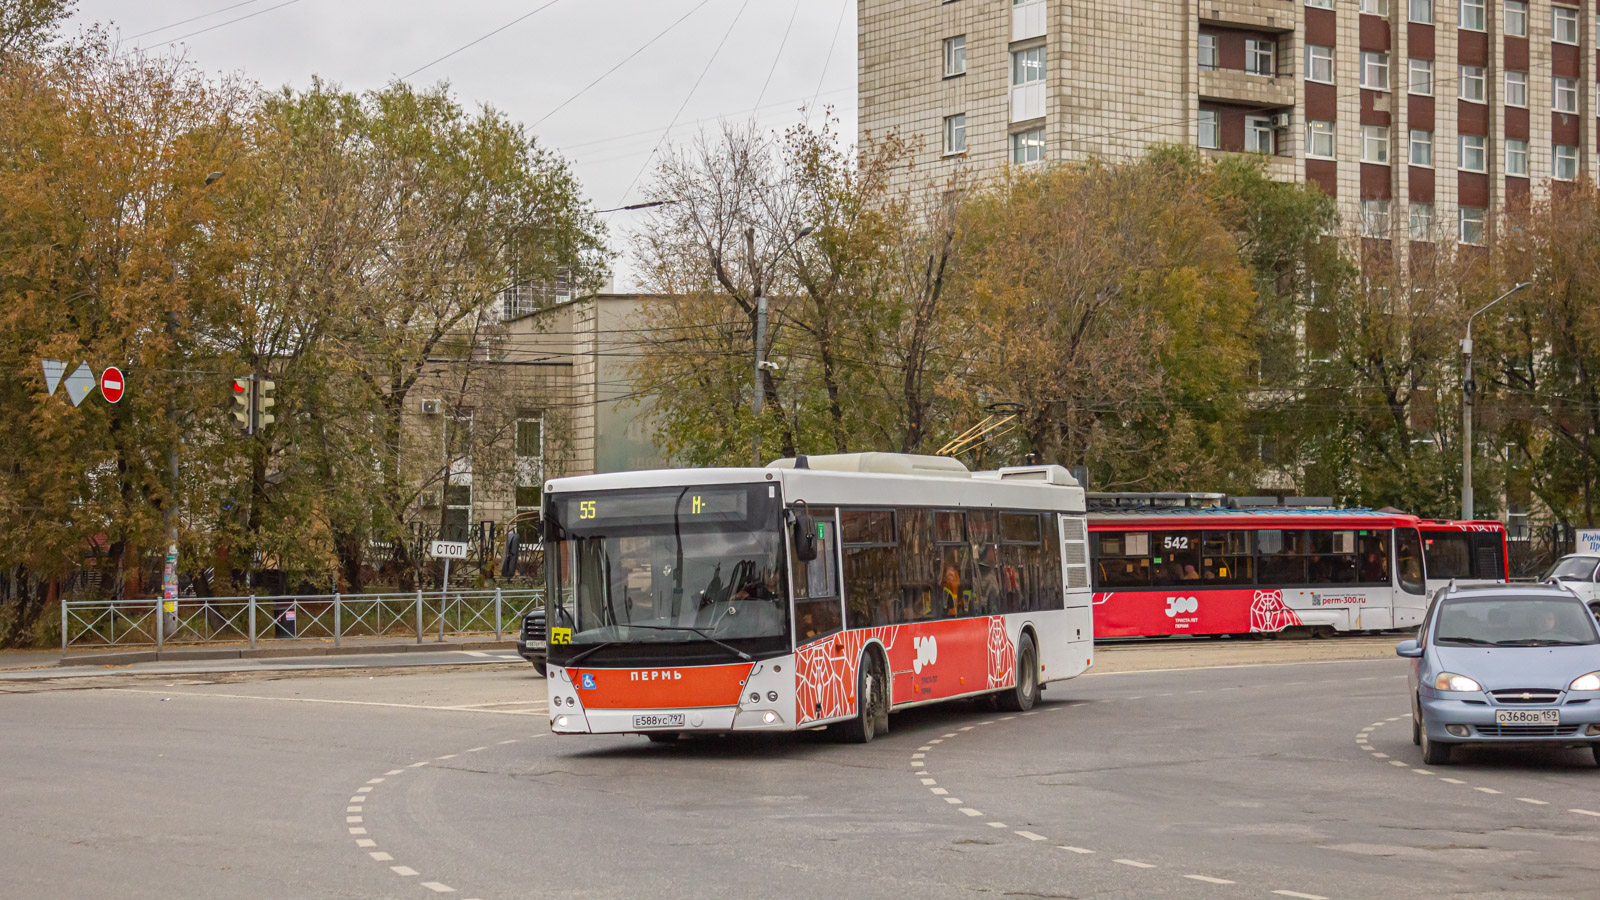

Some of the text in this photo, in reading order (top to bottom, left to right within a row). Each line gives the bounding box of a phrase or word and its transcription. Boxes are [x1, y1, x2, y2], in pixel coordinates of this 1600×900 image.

[580, 501, 596, 519] 55
[1164, 536, 1188, 549] 542
[437, 544, 463, 555] СТОП
[1322, 596, 1366, 606] perm-300.ru
[1165, 596, 1198, 618] 300
[553, 632, 570, 645] 55
[630, 671, 682, 681] ПЕРМЬ
[669, 714, 682, 722] 797
[1541, 711, 1557, 719] 159
